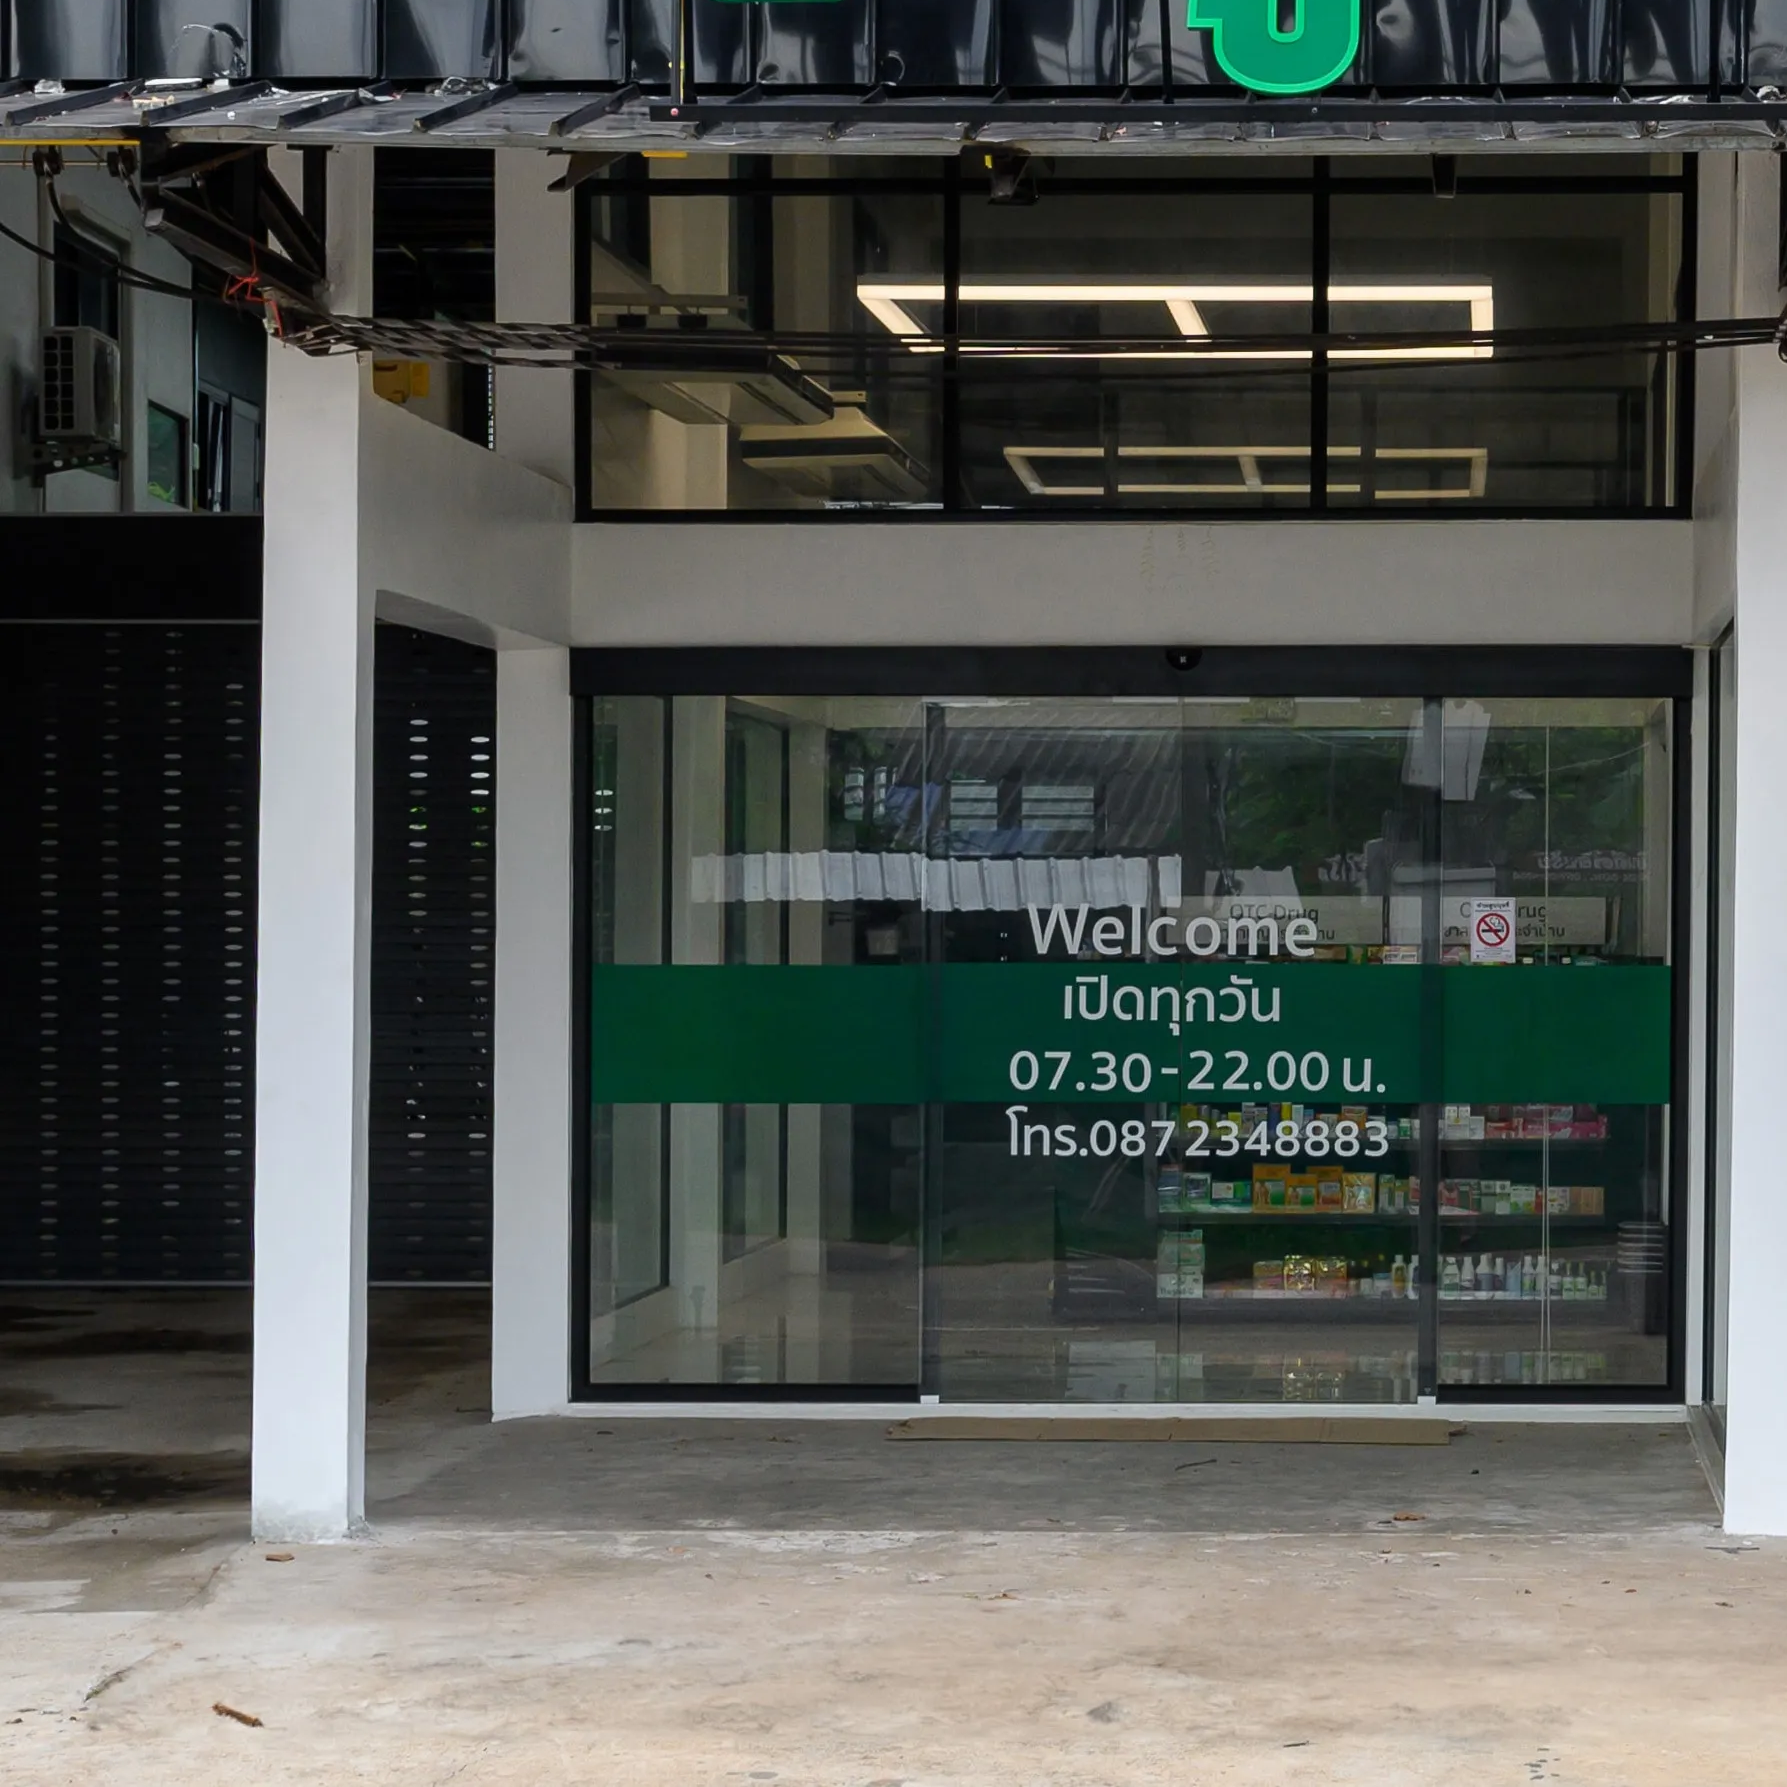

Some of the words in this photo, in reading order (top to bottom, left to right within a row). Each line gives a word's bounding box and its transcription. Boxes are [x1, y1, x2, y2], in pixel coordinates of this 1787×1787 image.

[1028, 903, 1318, 957] Welcome
[1063, 974, 1281, 1036] เปิดทุกวัน
[1343, 1057, 1387, 1093] น.
